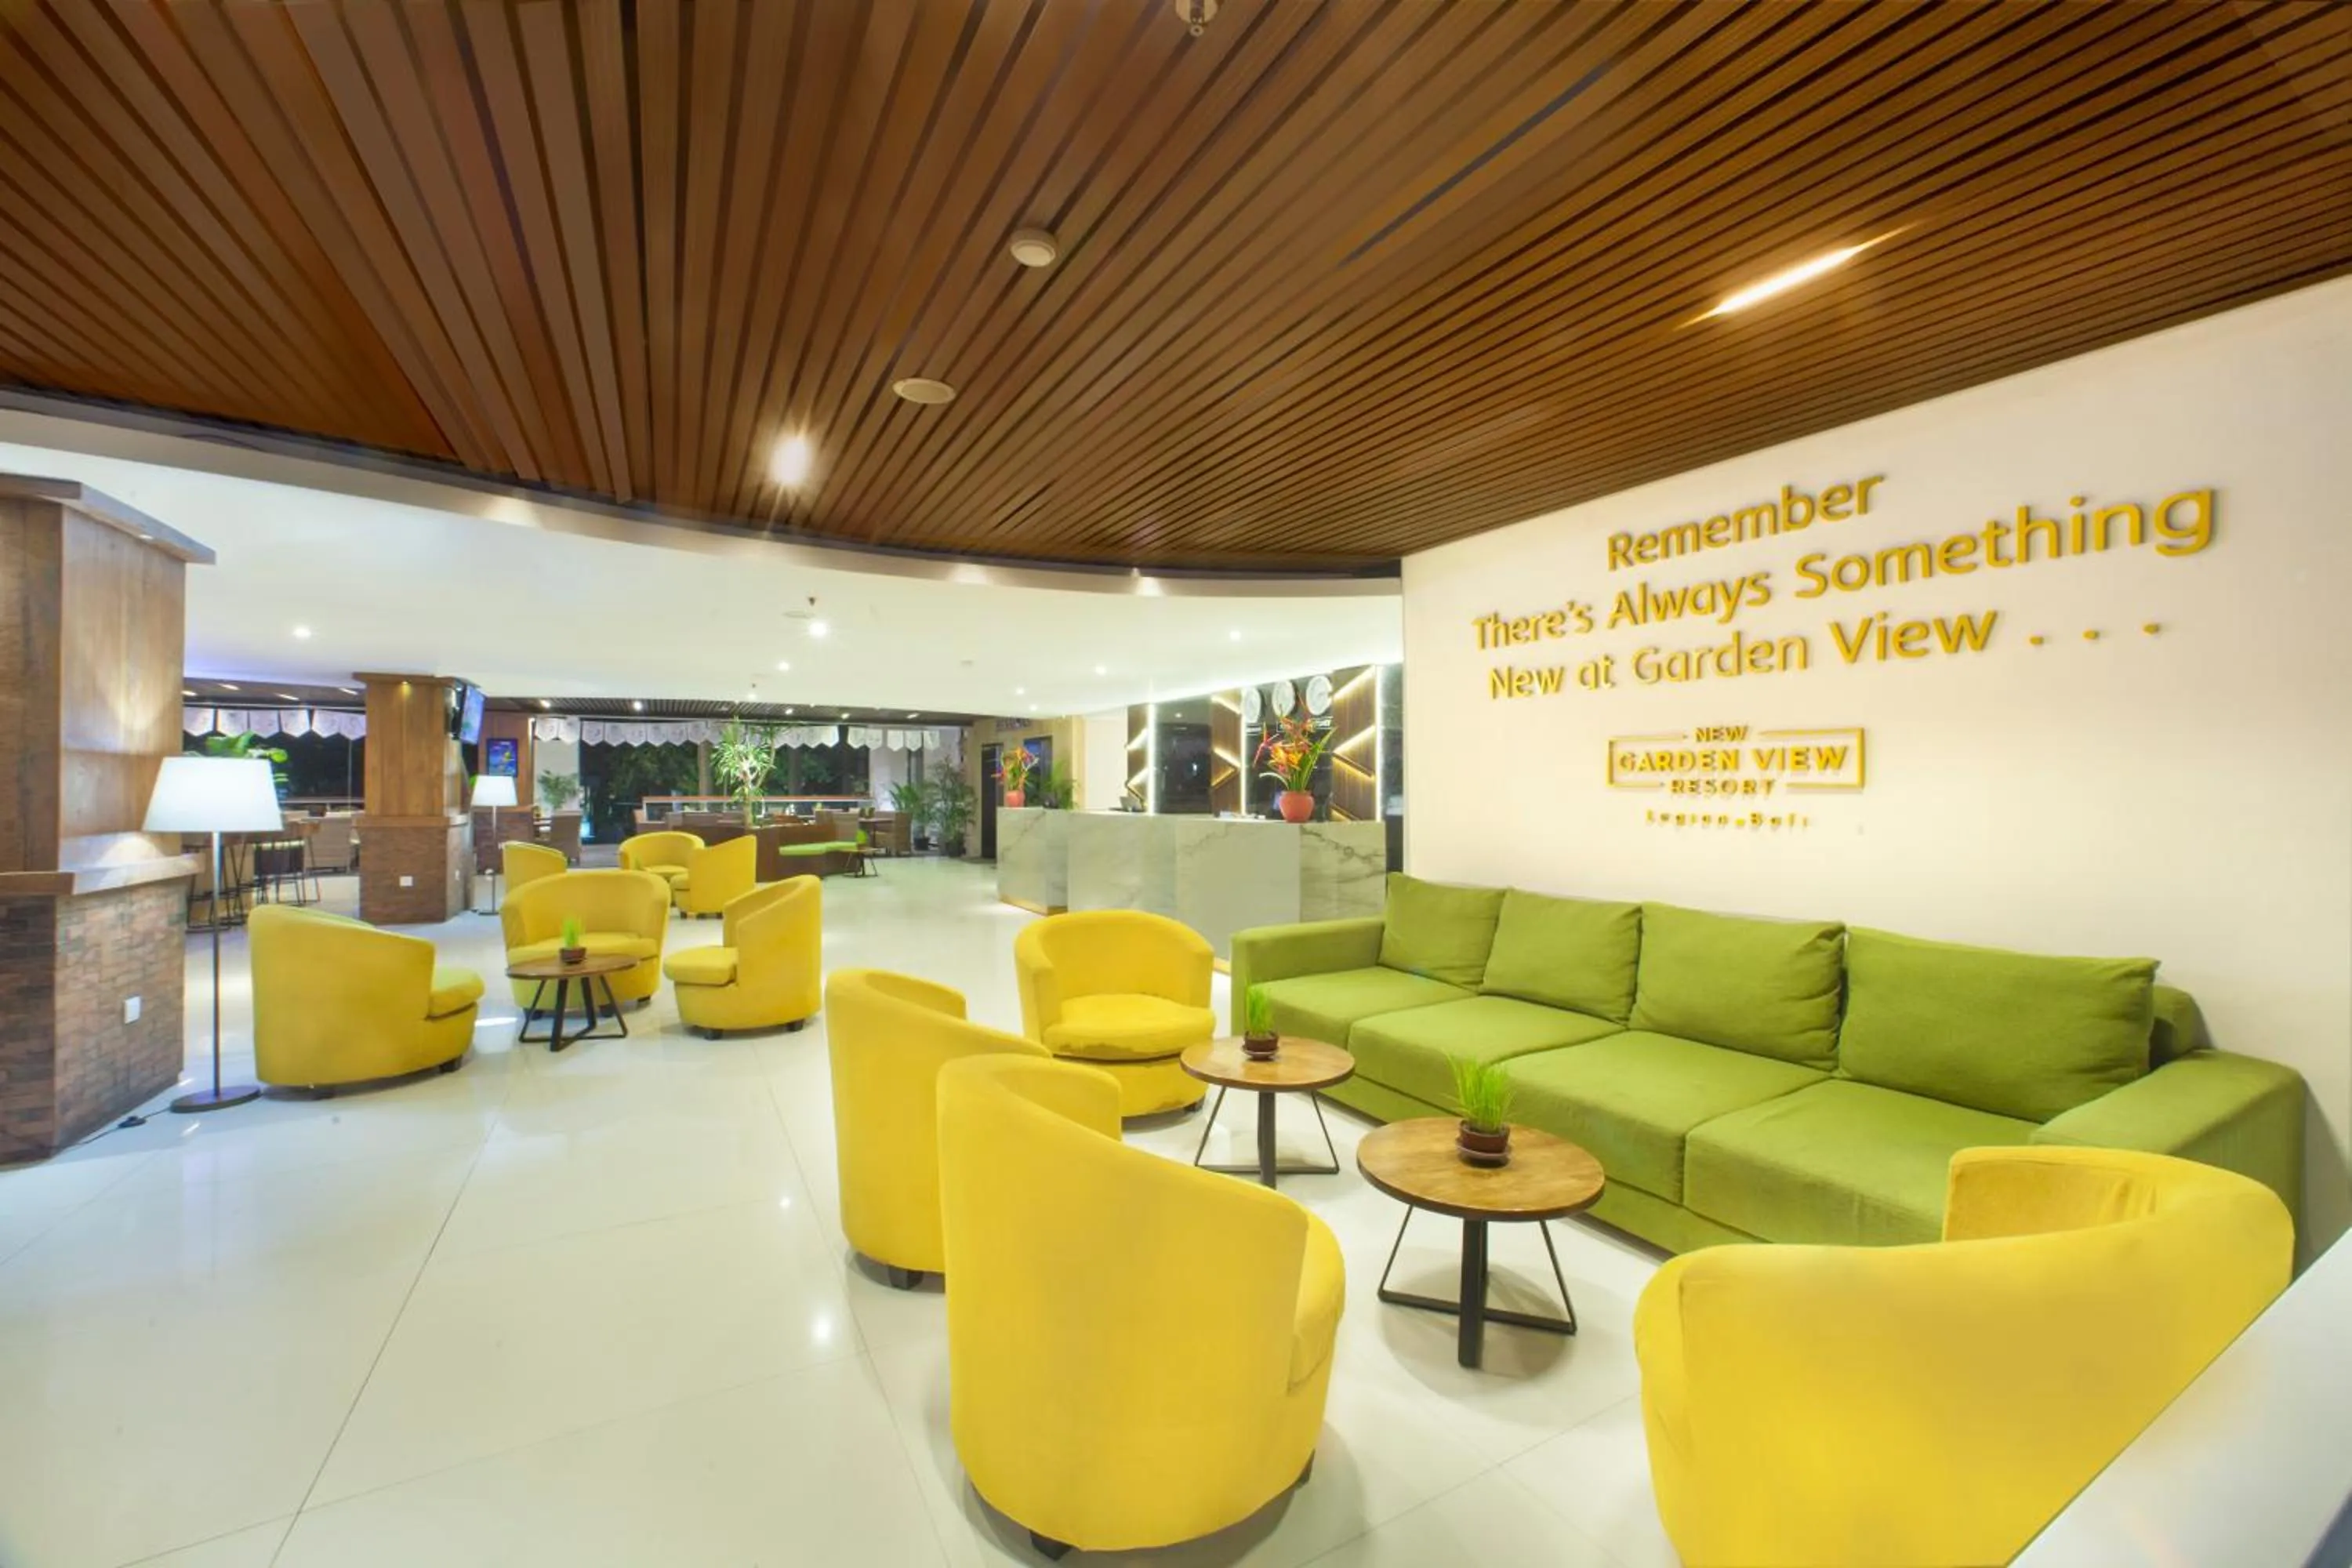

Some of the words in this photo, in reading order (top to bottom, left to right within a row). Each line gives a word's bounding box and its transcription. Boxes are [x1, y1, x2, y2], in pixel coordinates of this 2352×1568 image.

[1607, 474, 1885, 571] Remember
[1472, 600, 1595, 650] There's
[1607, 570, 1772, 628] Always
[1795, 487, 2216, 599] Something
[1490, 666, 1564, 699] New
[1577, 652, 1613, 690] at
[1632, 630, 1809, 685] Garden
[1829, 610, 1998, 664] View
[1618, 749, 1740, 772] GARDEN
[1751, 746, 1849, 771] VIEW
[1694, 726, 1749, 742] NEW
[1671, 779, 1776, 795] RESORT
